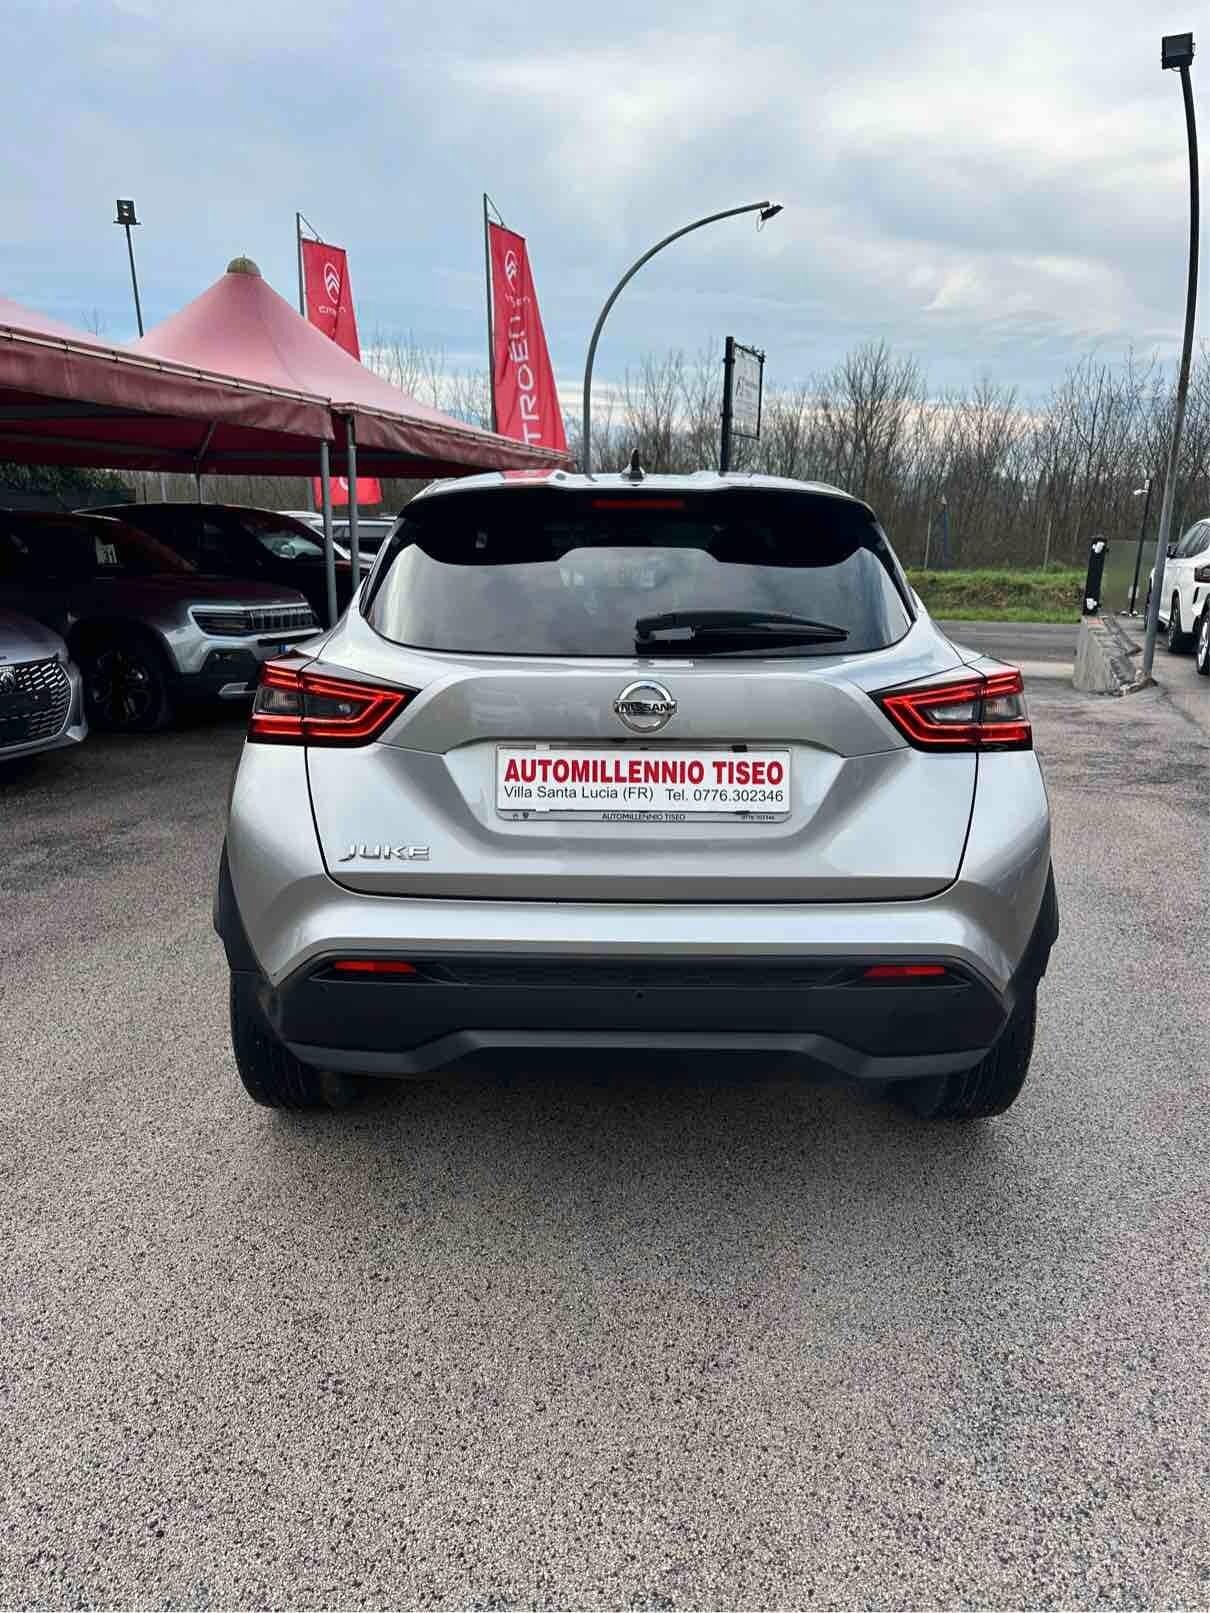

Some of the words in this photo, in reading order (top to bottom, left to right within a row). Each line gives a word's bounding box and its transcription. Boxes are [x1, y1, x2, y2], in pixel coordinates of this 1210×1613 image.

[619, 702, 670, 713] NISSAN
[504, 758, 705, 785] AUTOMILLENNIO
[712, 760, 784, 785] TISEO
[504, 785, 532, 798] Villa
[536, 786, 577, 799] Santa
[582, 786, 618, 799] Lucia
[623, 787, 654, 801] (FR)
[665, 788, 688, 801] Tel.
[693, 789, 784, 802] 0776.302346
[338, 844, 430, 862] JUKE
